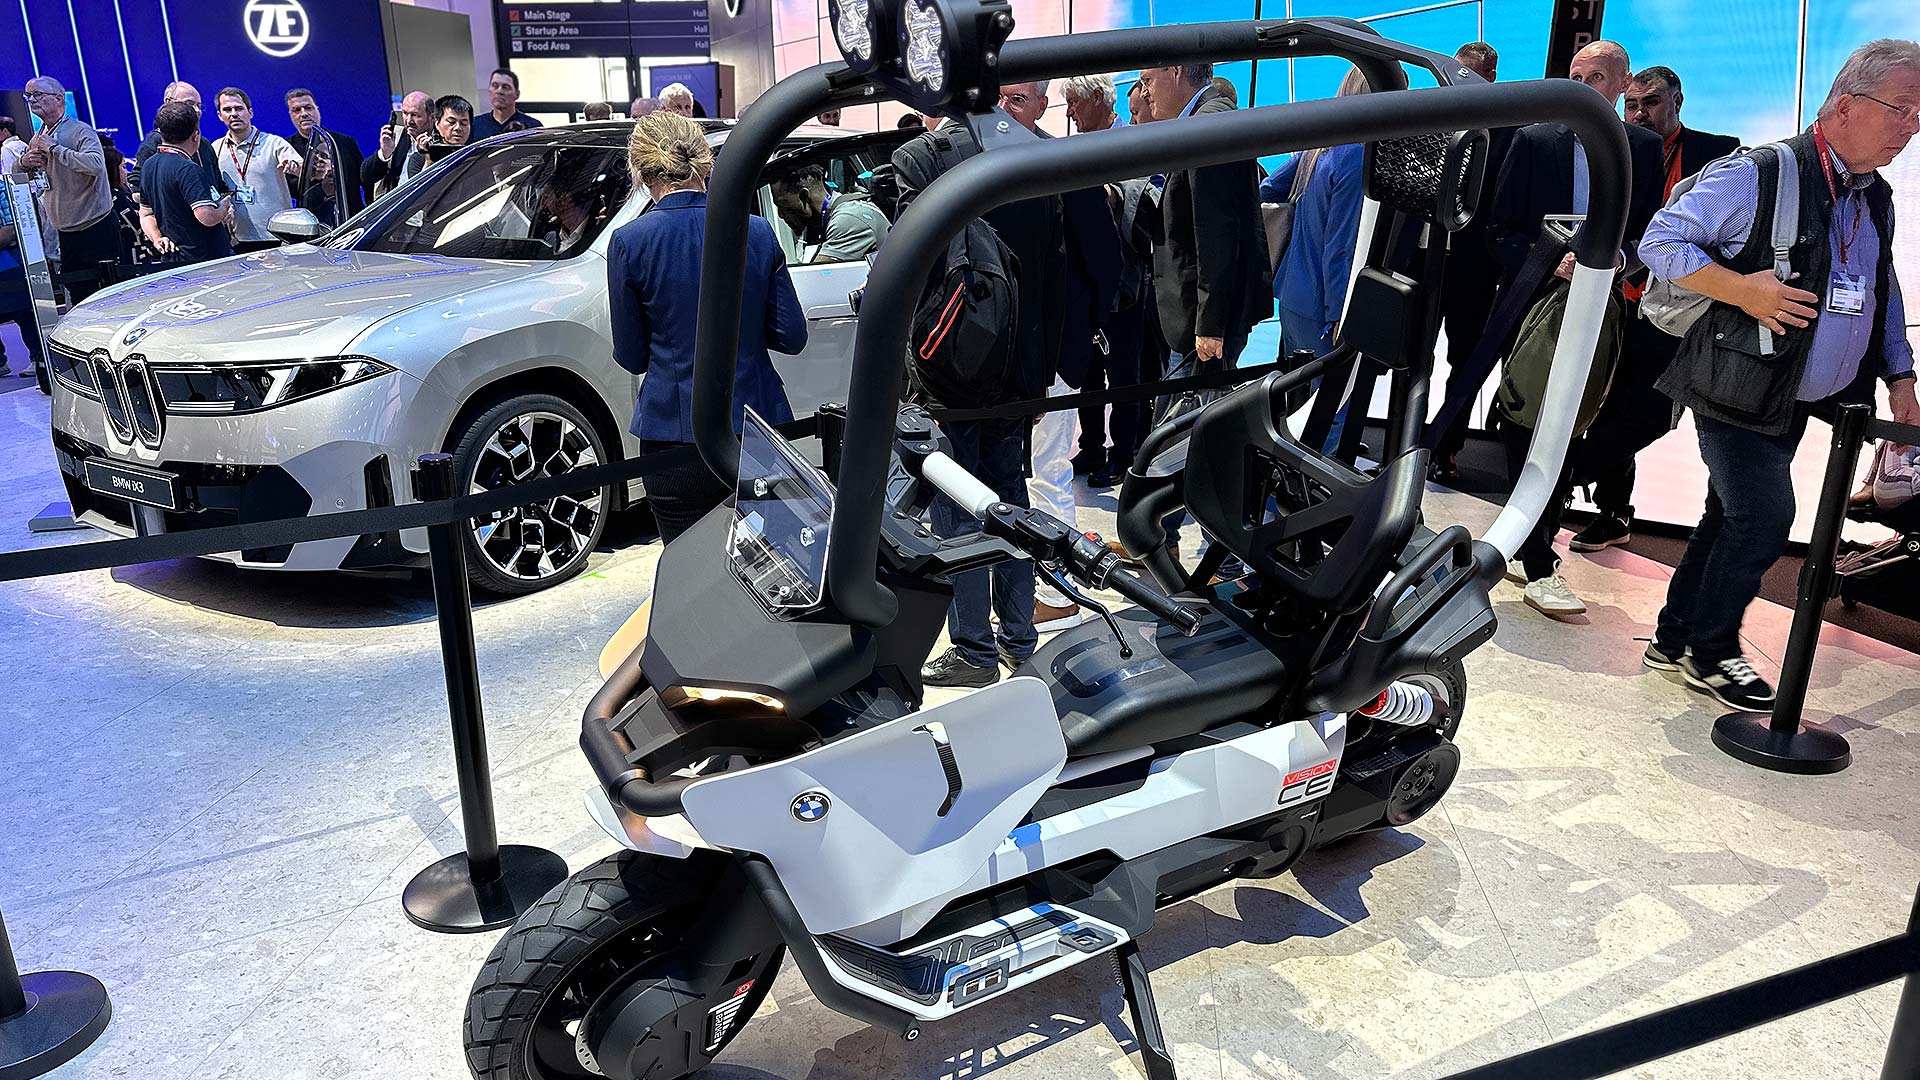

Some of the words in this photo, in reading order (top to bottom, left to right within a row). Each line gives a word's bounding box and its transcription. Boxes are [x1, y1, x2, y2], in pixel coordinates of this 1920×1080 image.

[524, 10, 545, 20] Main
[546, 10, 571, 21] Stage
[693, 9, 706, 17] Hall
[525, 25, 557, 36] Startup
[559, 25, 579, 35] Area
[694, 25, 707, 33] Hall
[527, 41, 549, 50] Food
[550, 41, 570, 50] Area
[695, 40, 708, 48] Hall
[112, 476, 131, 490] BMW
[131, 480, 145, 494] iX3
[1286, 761, 1336, 784] VISION
[1278, 771, 1334, 805] CE
[795, 796, 822, 809] BMW
